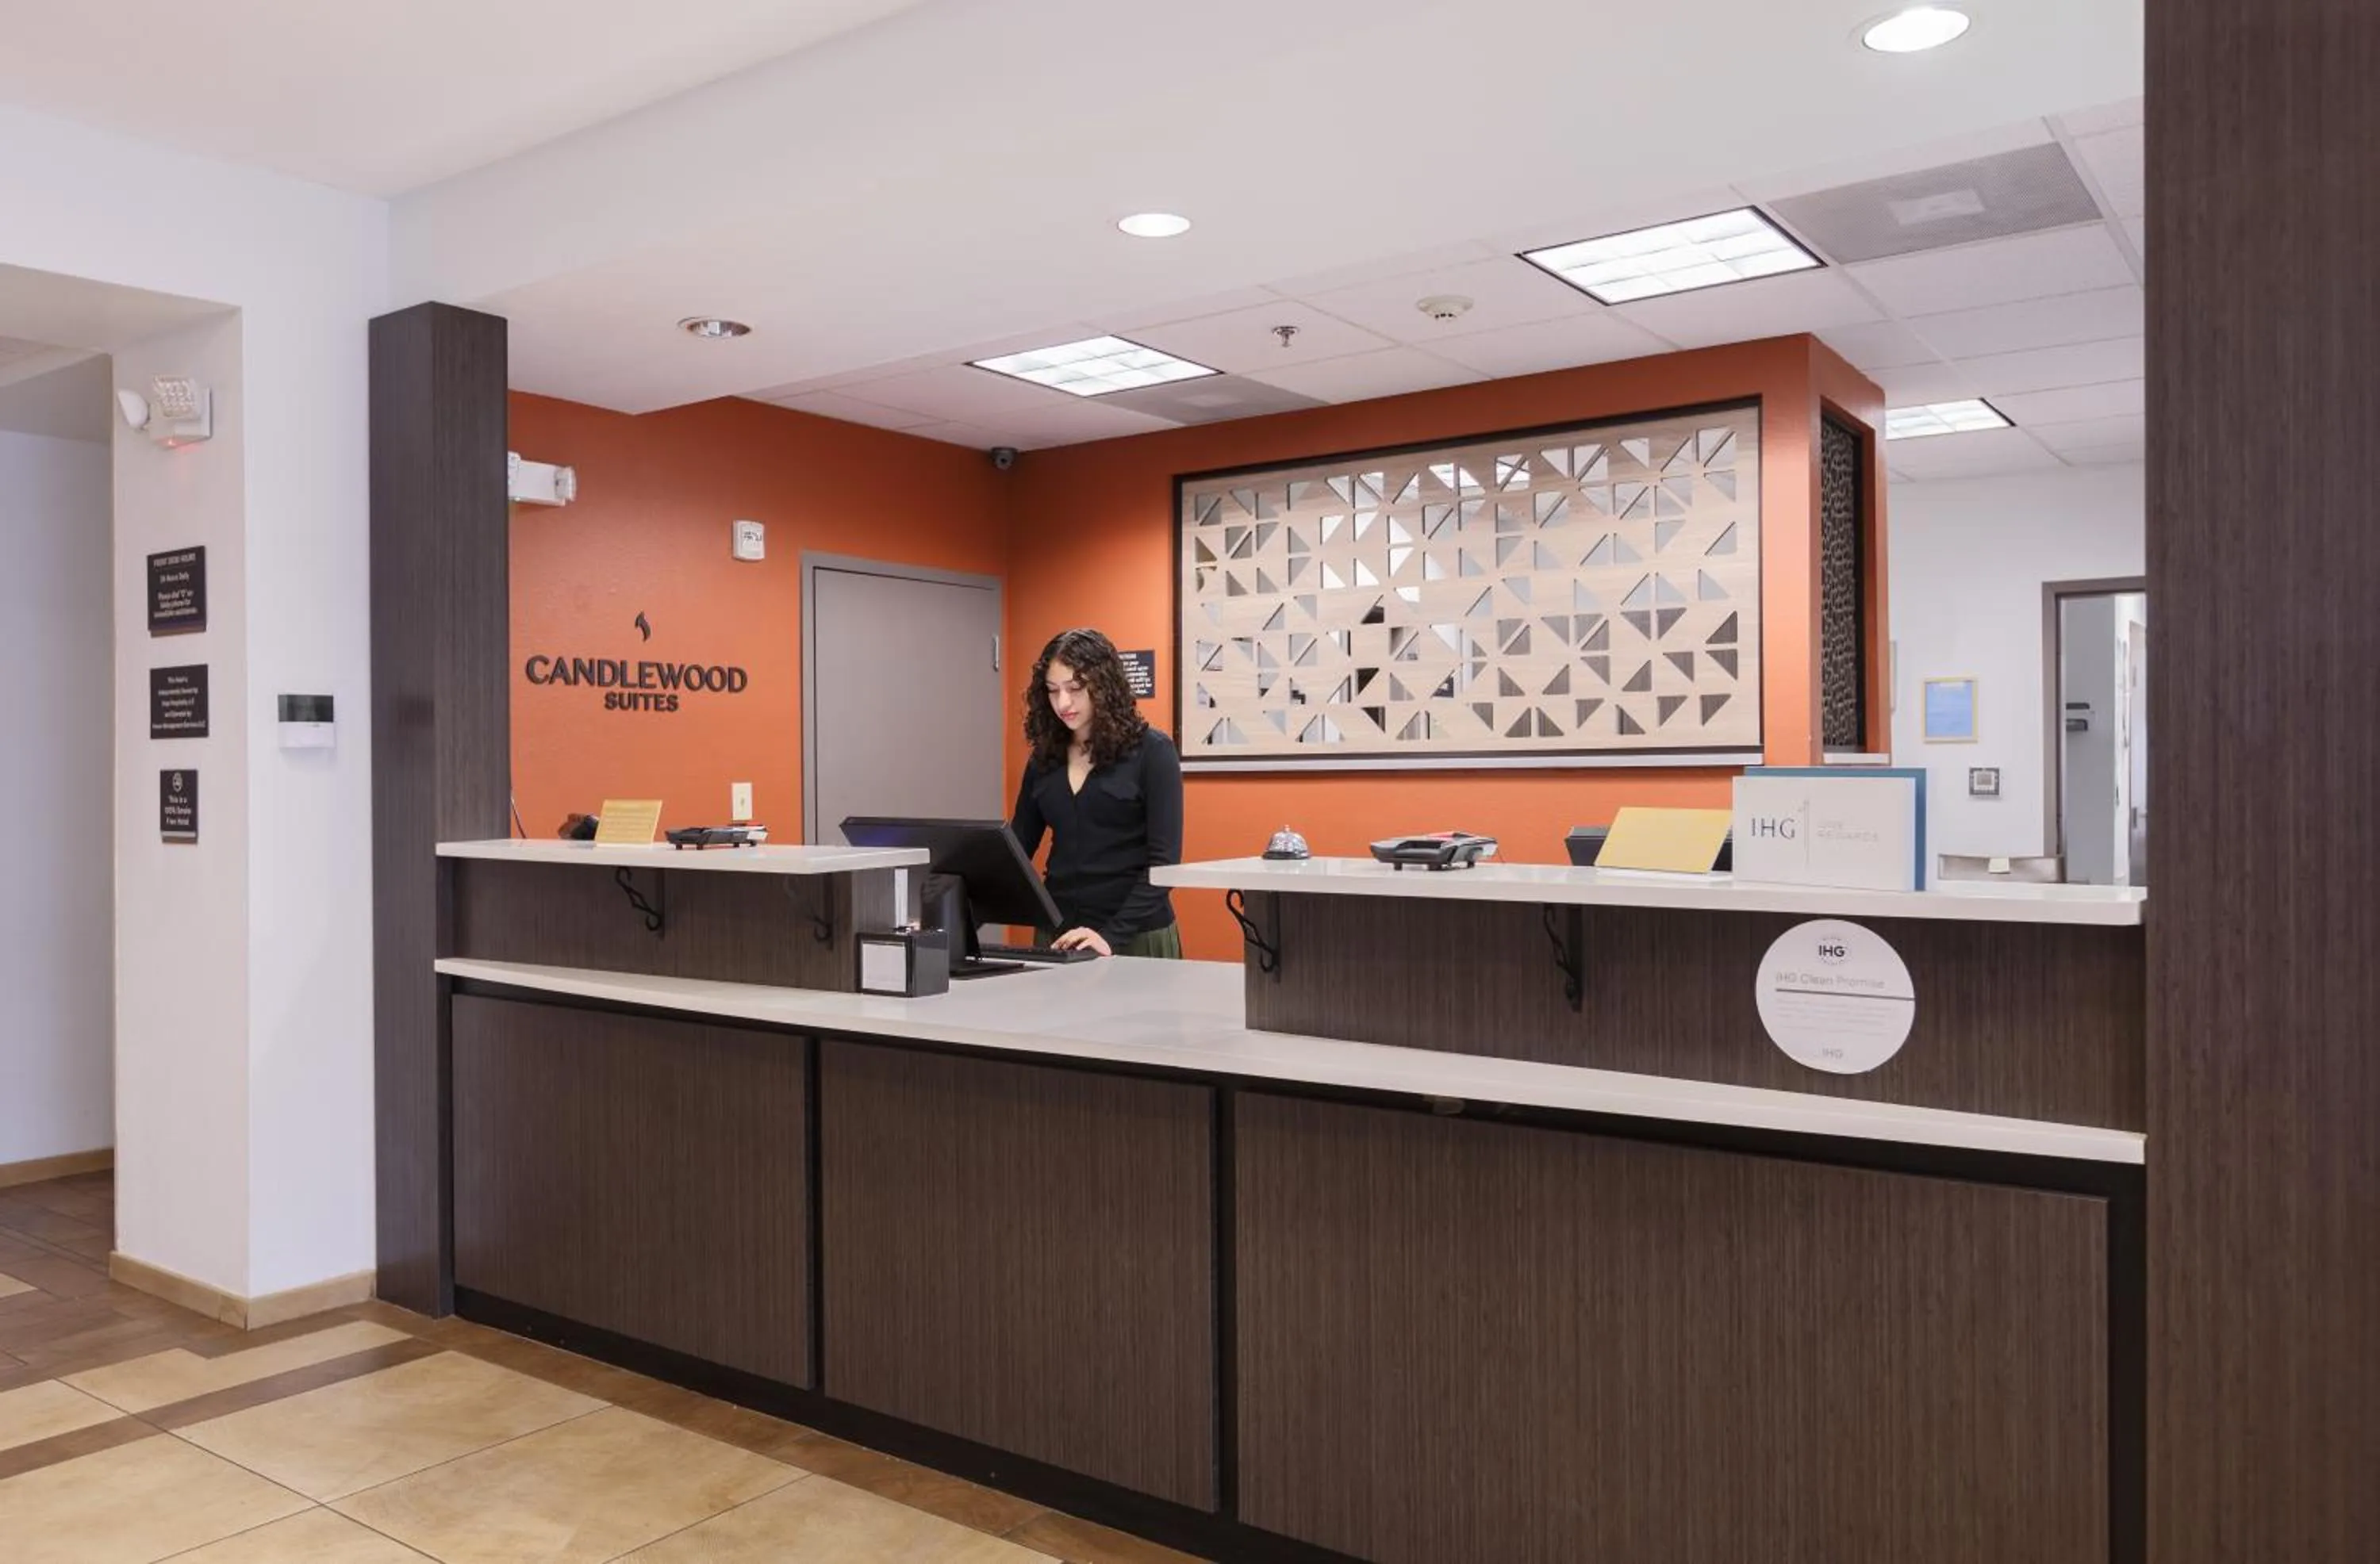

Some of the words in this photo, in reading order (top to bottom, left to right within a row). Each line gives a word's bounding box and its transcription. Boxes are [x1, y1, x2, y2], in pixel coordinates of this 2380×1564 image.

[525, 654, 748, 694] CANDLEWOOD
[605, 691, 679, 712] SUITES
[1751, 817, 1795, 840] IHG
[1818, 945, 1845, 957] IHG
[1775, 972, 1798, 984] IHG
[1799, 972, 1833, 985] Clean
[1836, 975, 1886, 989] Promise
[1822, 1047, 1844, 1060] IHG
